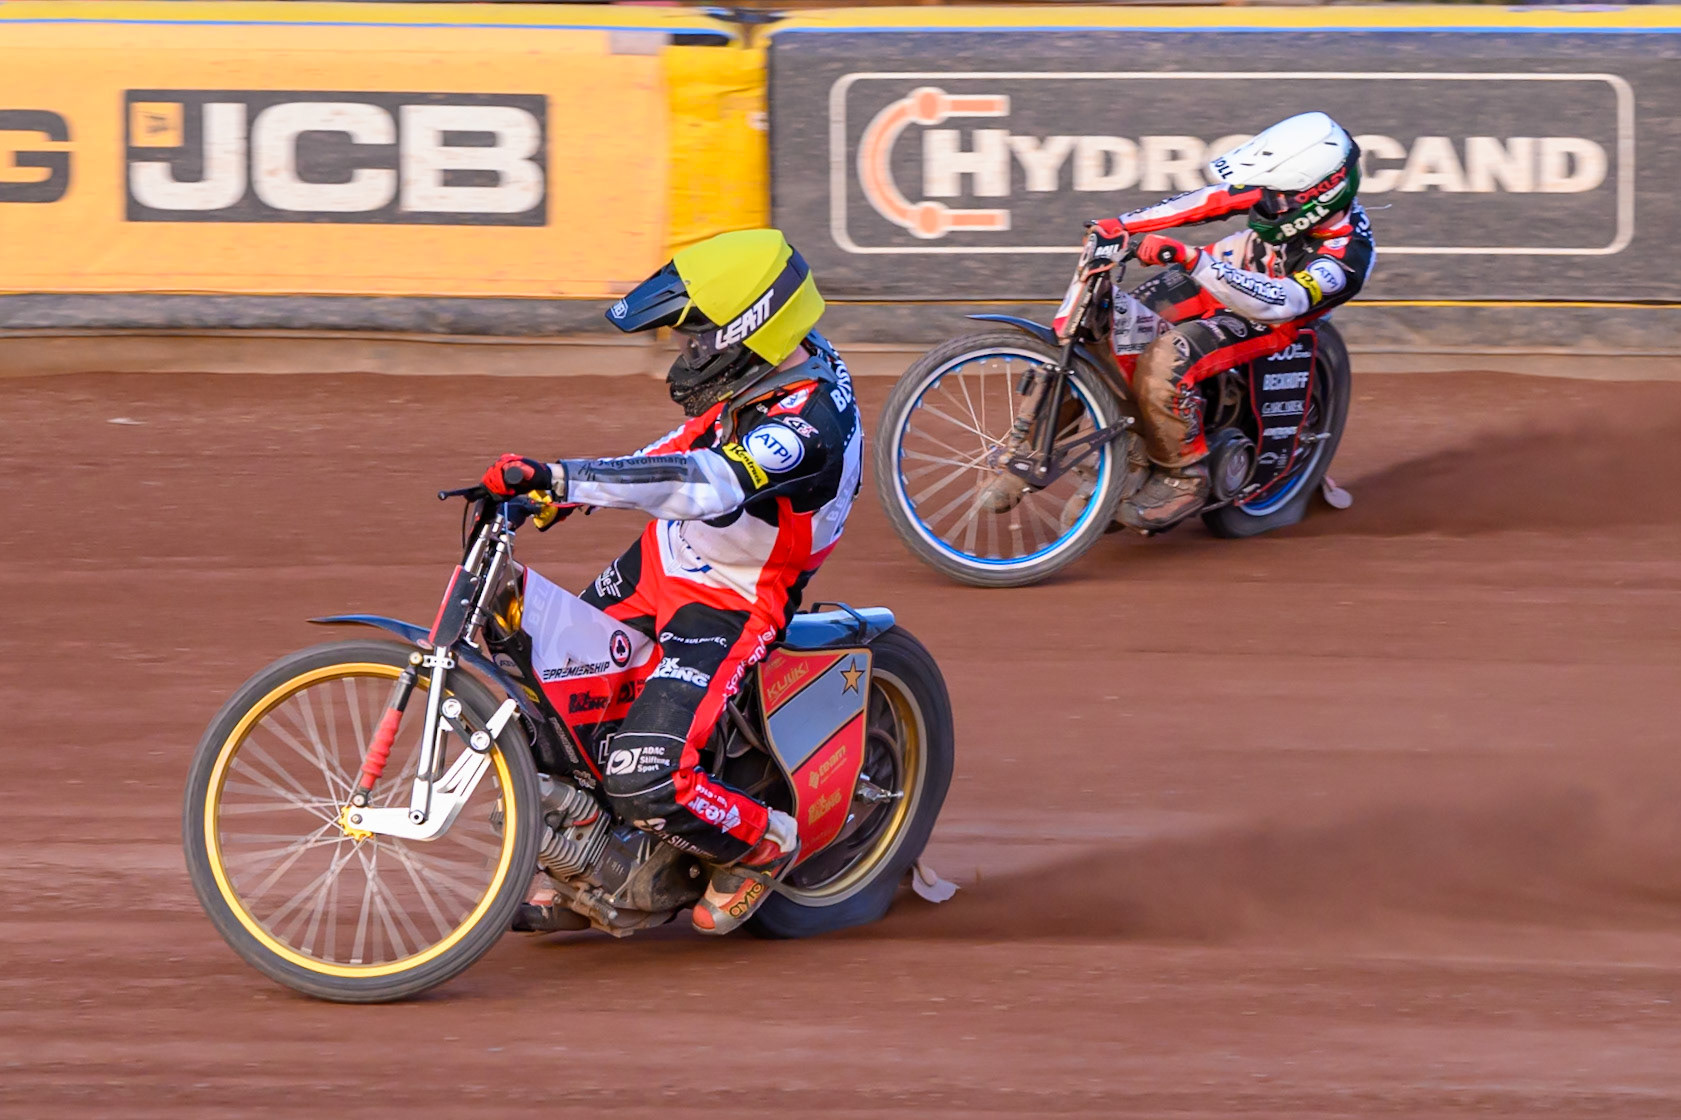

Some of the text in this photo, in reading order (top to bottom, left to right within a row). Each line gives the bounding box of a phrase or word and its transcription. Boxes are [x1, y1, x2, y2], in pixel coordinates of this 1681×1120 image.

[129, 102, 545, 213] JCB
[921, 129, 1608, 197] HYDRCAND
[1212, 158, 1235, 180] OLL
[1280, 203, 1331, 238] BOLL
[715, 288, 775, 350] LEATT
[754, 433, 793, 465] ATPI
[639, 755, 671, 768] Stiftung
[641, 746, 666, 757] ADAC
[637, 763, 660, 773] Sport
